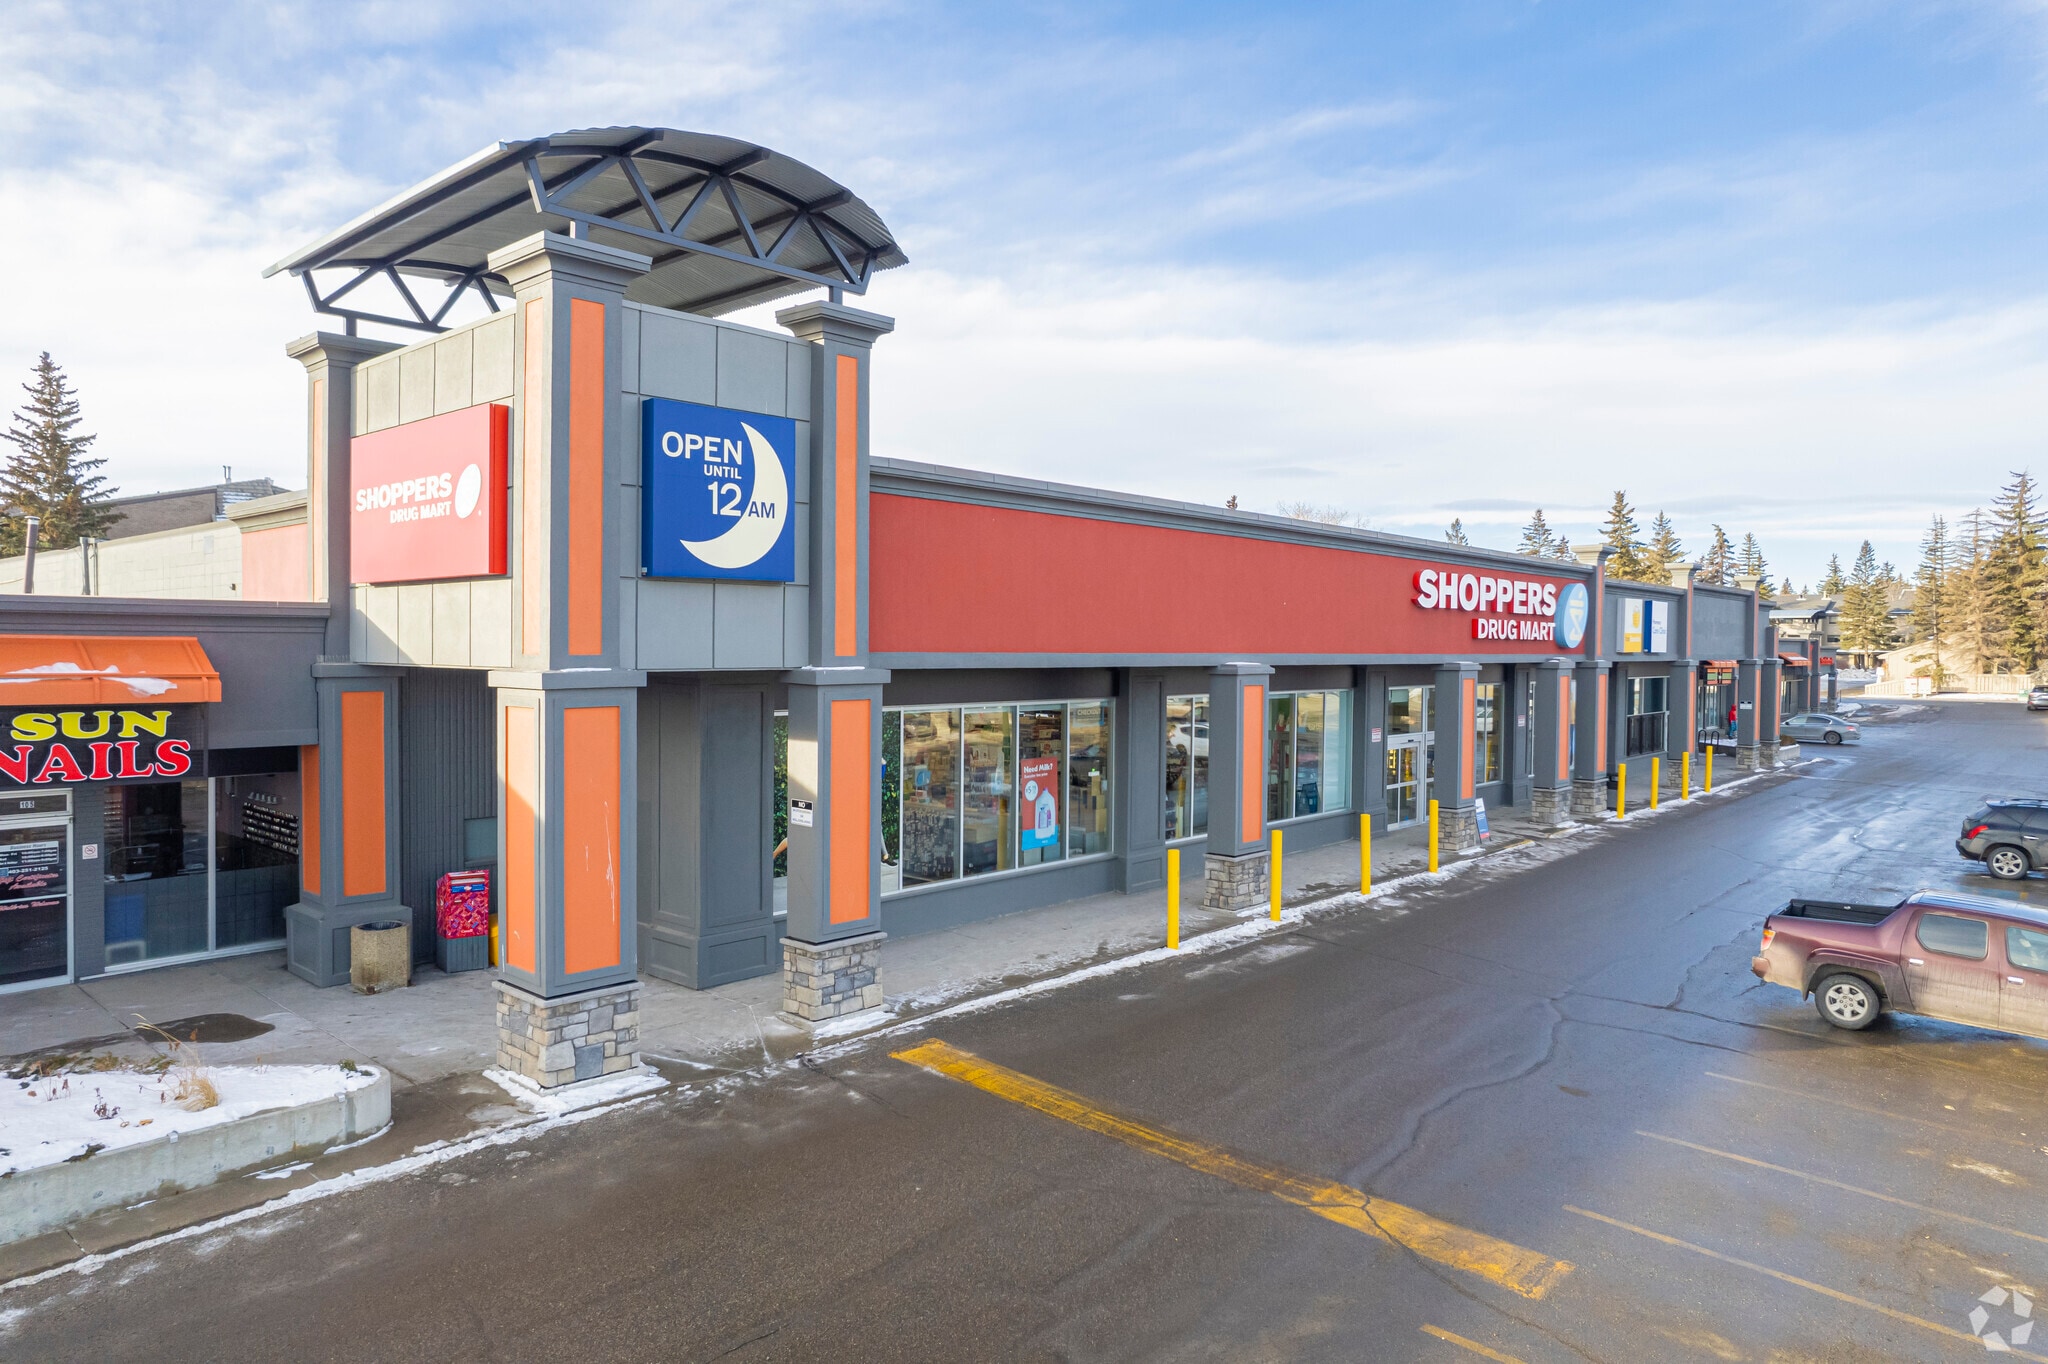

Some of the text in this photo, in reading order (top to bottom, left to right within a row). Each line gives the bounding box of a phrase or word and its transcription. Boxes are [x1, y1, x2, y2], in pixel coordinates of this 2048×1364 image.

[661, 431, 743, 465] OPEN
[703, 464, 742, 479] UNTIL
[355, 472, 453, 512] SHOPPERS
[707, 481, 776, 519] 12 AM
[389, 501, 452, 524] DRUG MART
[1414, 568, 1557, 617] SHOPPERS
[1475, 618, 1557, 642] DRUG MART
[10, 710, 173, 742] SUN
[0, 739, 191, 785] NAILS
[1023, 762, 1053, 773] Need Milk?
[19, 800, 34, 808] 105
